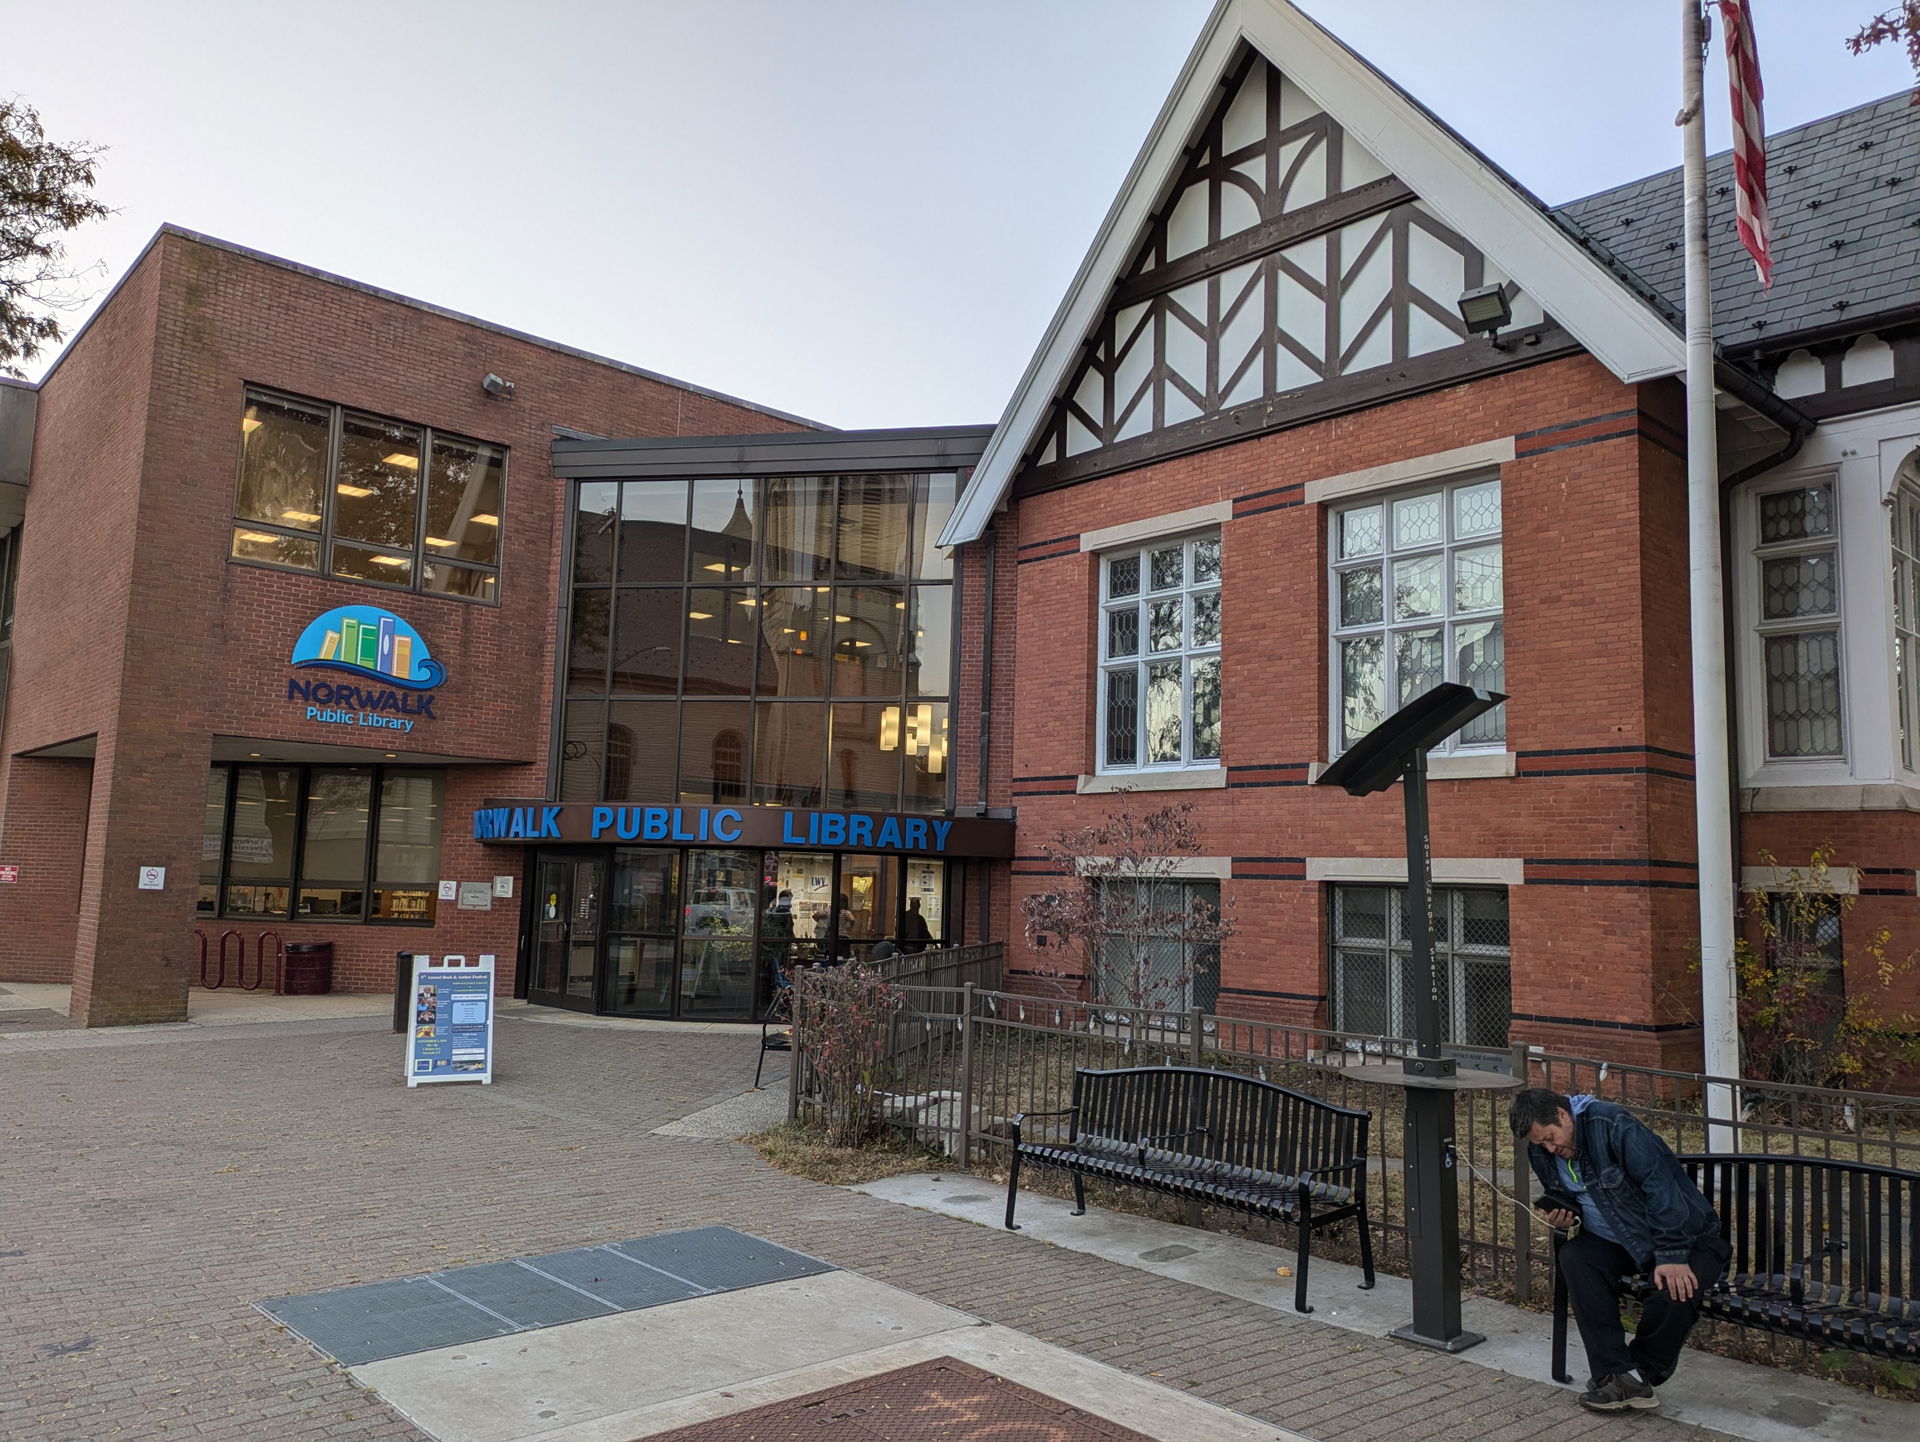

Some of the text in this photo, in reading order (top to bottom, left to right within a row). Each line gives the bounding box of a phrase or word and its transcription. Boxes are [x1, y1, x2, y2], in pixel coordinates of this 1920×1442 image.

[287, 678, 437, 720] NORWALK
[306, 706, 415, 733] Public Library
[591, 806, 743, 843] PUBLIC
[783, 811, 954, 852] LIBRARY
[1423, 834, 1431, 873] Solar
[1429, 947, 1438, 1001] Station
